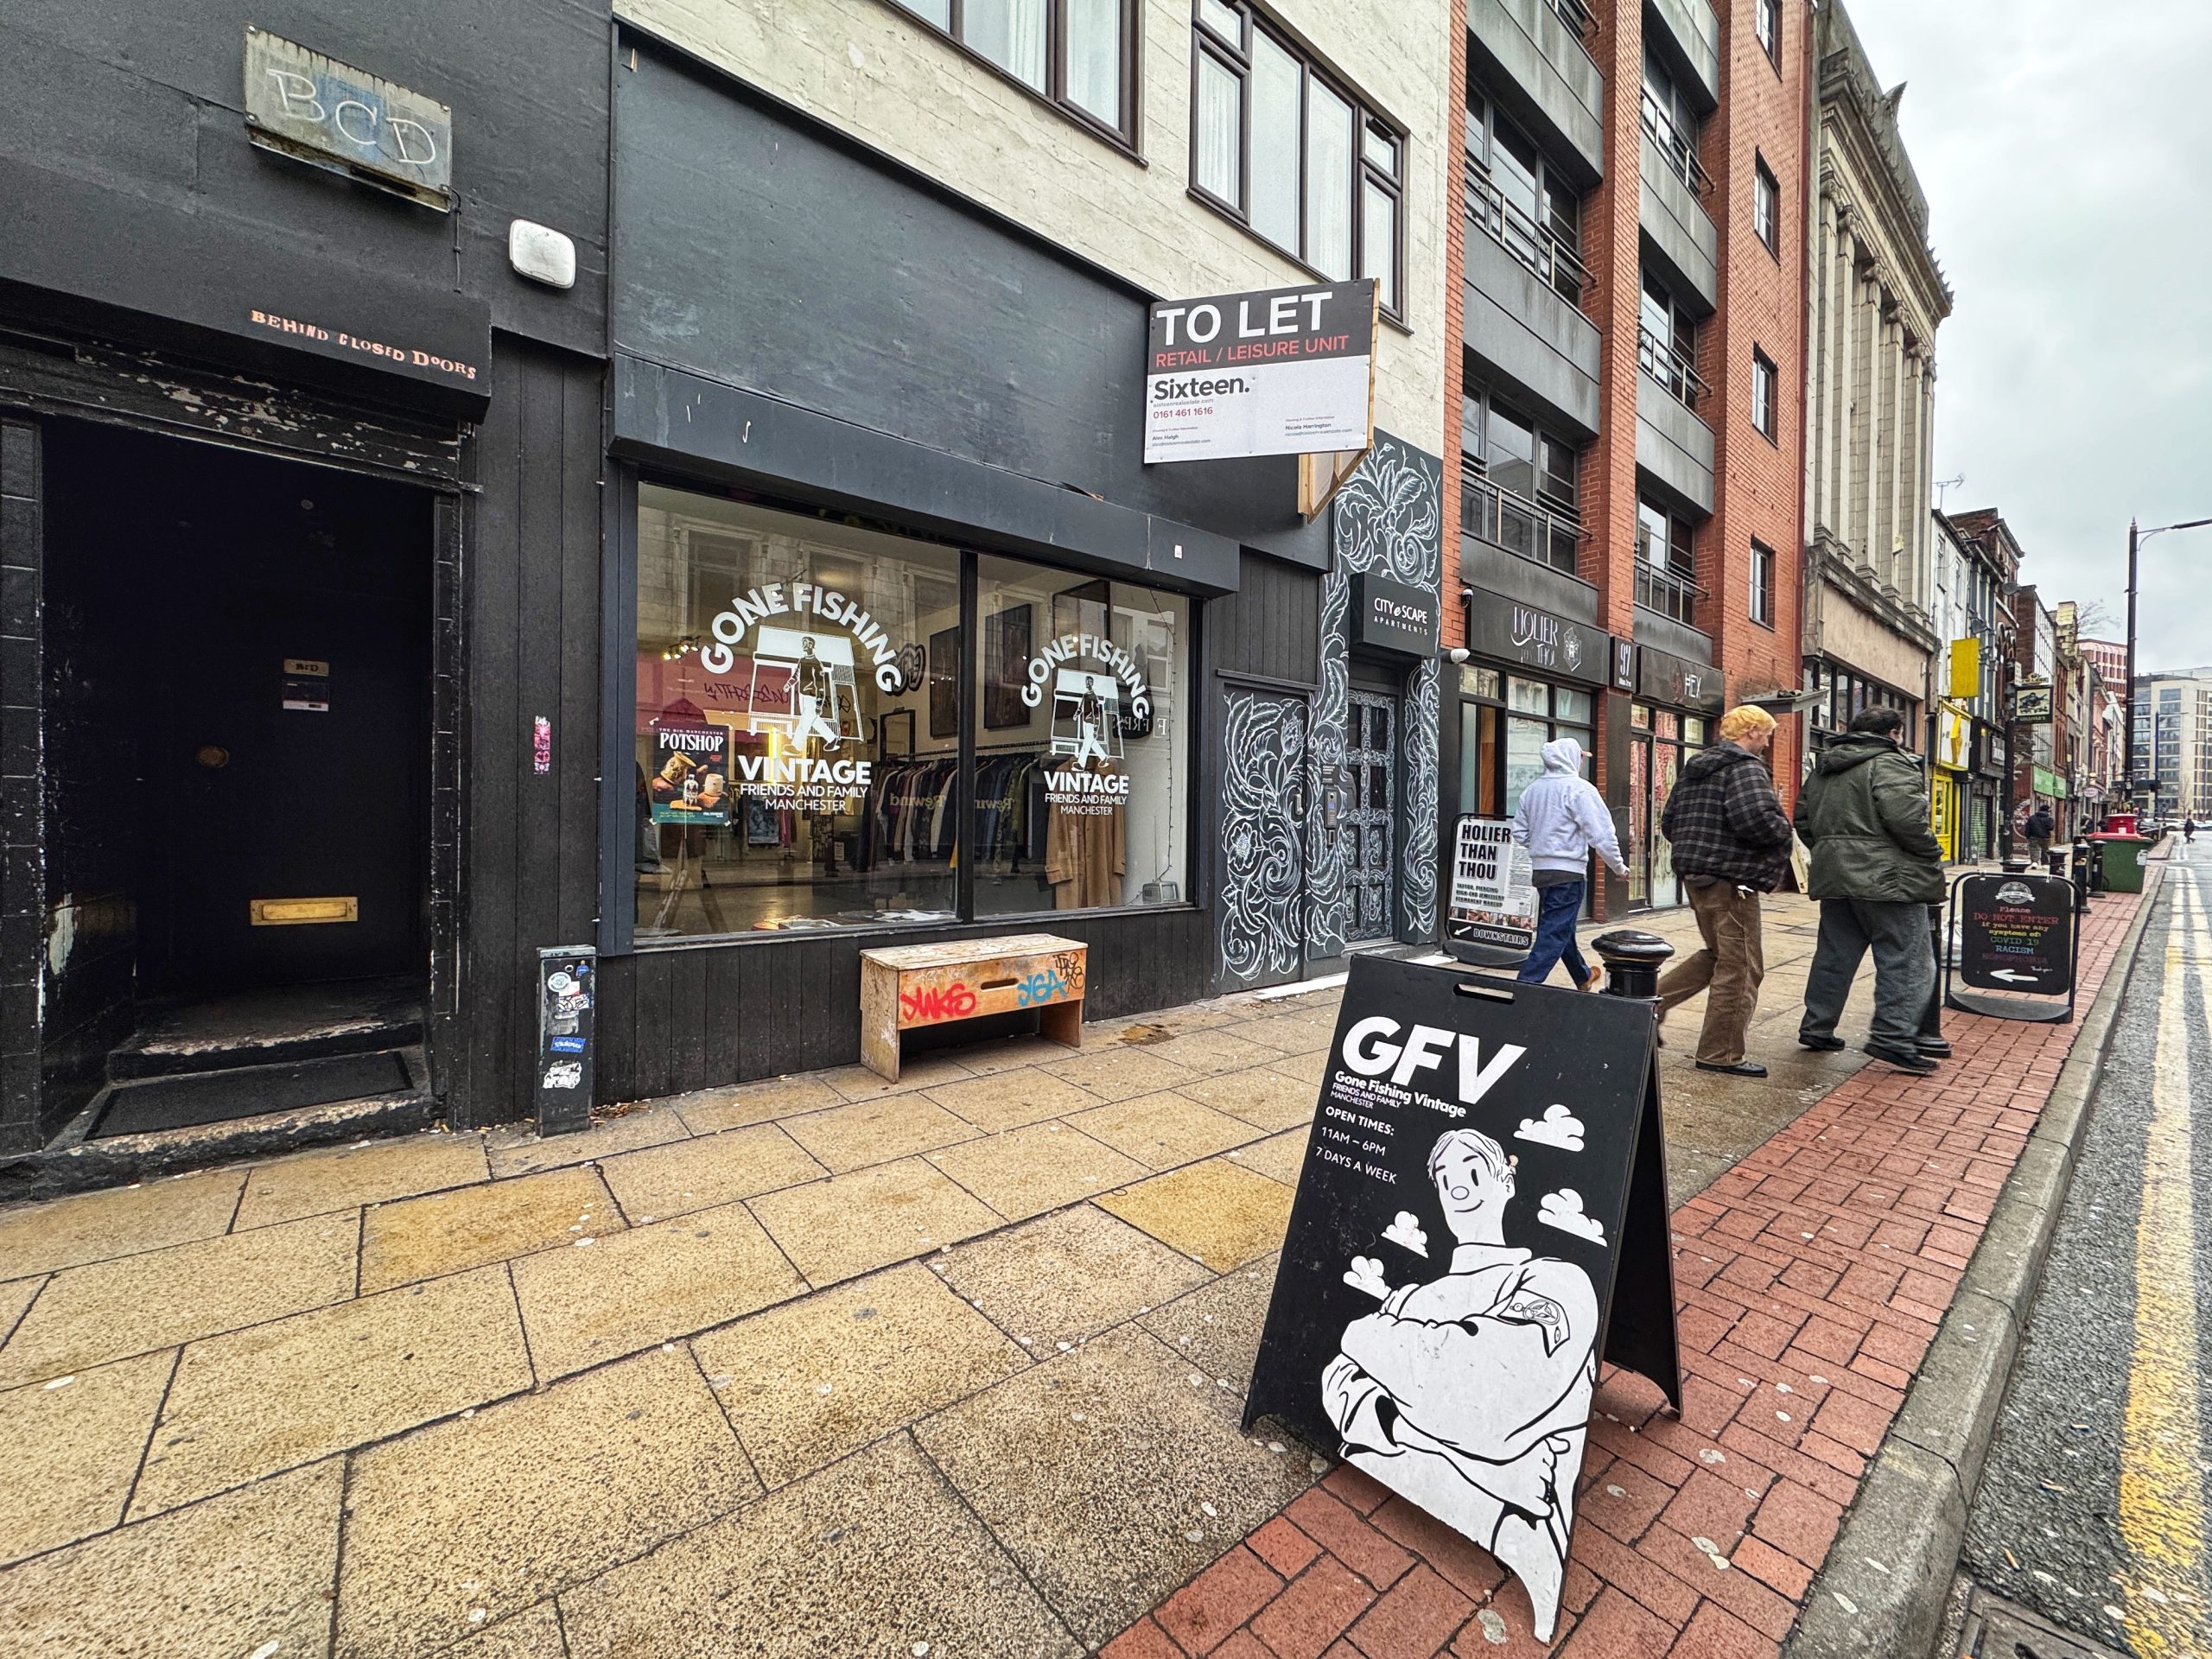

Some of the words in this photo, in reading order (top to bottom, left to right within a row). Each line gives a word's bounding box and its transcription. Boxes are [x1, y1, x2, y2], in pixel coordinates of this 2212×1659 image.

[266, 69, 435, 164] BCD
[1156, 304, 1221, 346] TO
[1238, 291, 1333, 338] LET
[251, 309, 329, 341] BEHIND
[339, 332, 405, 363] CLOSED
[411, 349, 476, 379] DOORS
[1155, 349, 1211, 367] RETAIL
[1216, 347, 1223, 361] /
[1227, 340, 1300, 360] LEISURE
[1306, 335, 1349, 353] UNIT
[1154, 377, 1250, 401] Sixteen.
[1153, 410, 1173, 420] 0161
[1175, 408, 1191, 418] 461
[1193, 406, 1213, 416] 1616
[701, 582, 789, 674] GONE
[792, 582, 902, 693] FISHING
[1374, 615, 1428, 636] APARTMENTS
[1510, 606, 1559, 646] HOLIER
[1620, 643, 1631, 677] 97
[1021, 633, 1078, 707] GONE
[1079, 632, 1150, 719] FISHING
[659, 732, 724, 752] POTSHOP
[738, 755, 872, 785] VINTAGE
[741, 783, 794, 797] FRIENDS
[797, 785, 824, 797] AND
[827, 785, 868, 798] FAMILY
[1044, 771, 1130, 794] VINTAGE
[765, 798, 847, 811] MANCHESTER
[1045, 792, 1080, 804] FRIENDS
[1081, 793, 1099, 804] AND
[1100, 794, 1128, 805] FAMILY
[1060, 805, 1113, 816] MANCHESTER
[1461, 824, 1511, 843] HOLIER
[1460, 842, 1497, 861] THAN
[1459, 861, 1496, 880] THOU
[1973, 912, 1987, 921] DO
[2020, 915, 2059, 925] ENTER
[1473, 928, 1529, 945] DOWNSTAIRS
[1995, 945, 2034, 954] RACISM
[1342, 1016, 1528, 1105] GFV
[1330, 1090, 1374, 1109] MANCHESTER
[1332, 1082, 1361, 1098] FRIENDS
[1360, 1090, 1376, 1102] AND
[1376, 1095, 1402, 1109] FAMILY
[1335, 1071, 1367, 1090] Gone
[1368, 1079, 1412, 1104] Fishing
[1414, 1092, 1467, 1118] Vintage
[1325, 1106, 1357, 1123] OPEN
[1358, 1115, 1395, 1136] TIMES:
[1321, 1127, 1351, 1144] 11AM
[1362, 1140, 1386, 1157] 6PM
[1315, 1146, 1323, 1156] 7
[1324, 1149, 1352, 1168] DAYS
[1353, 1160, 1361, 1172] A
[1364, 1163, 1397, 1185] WEEK
